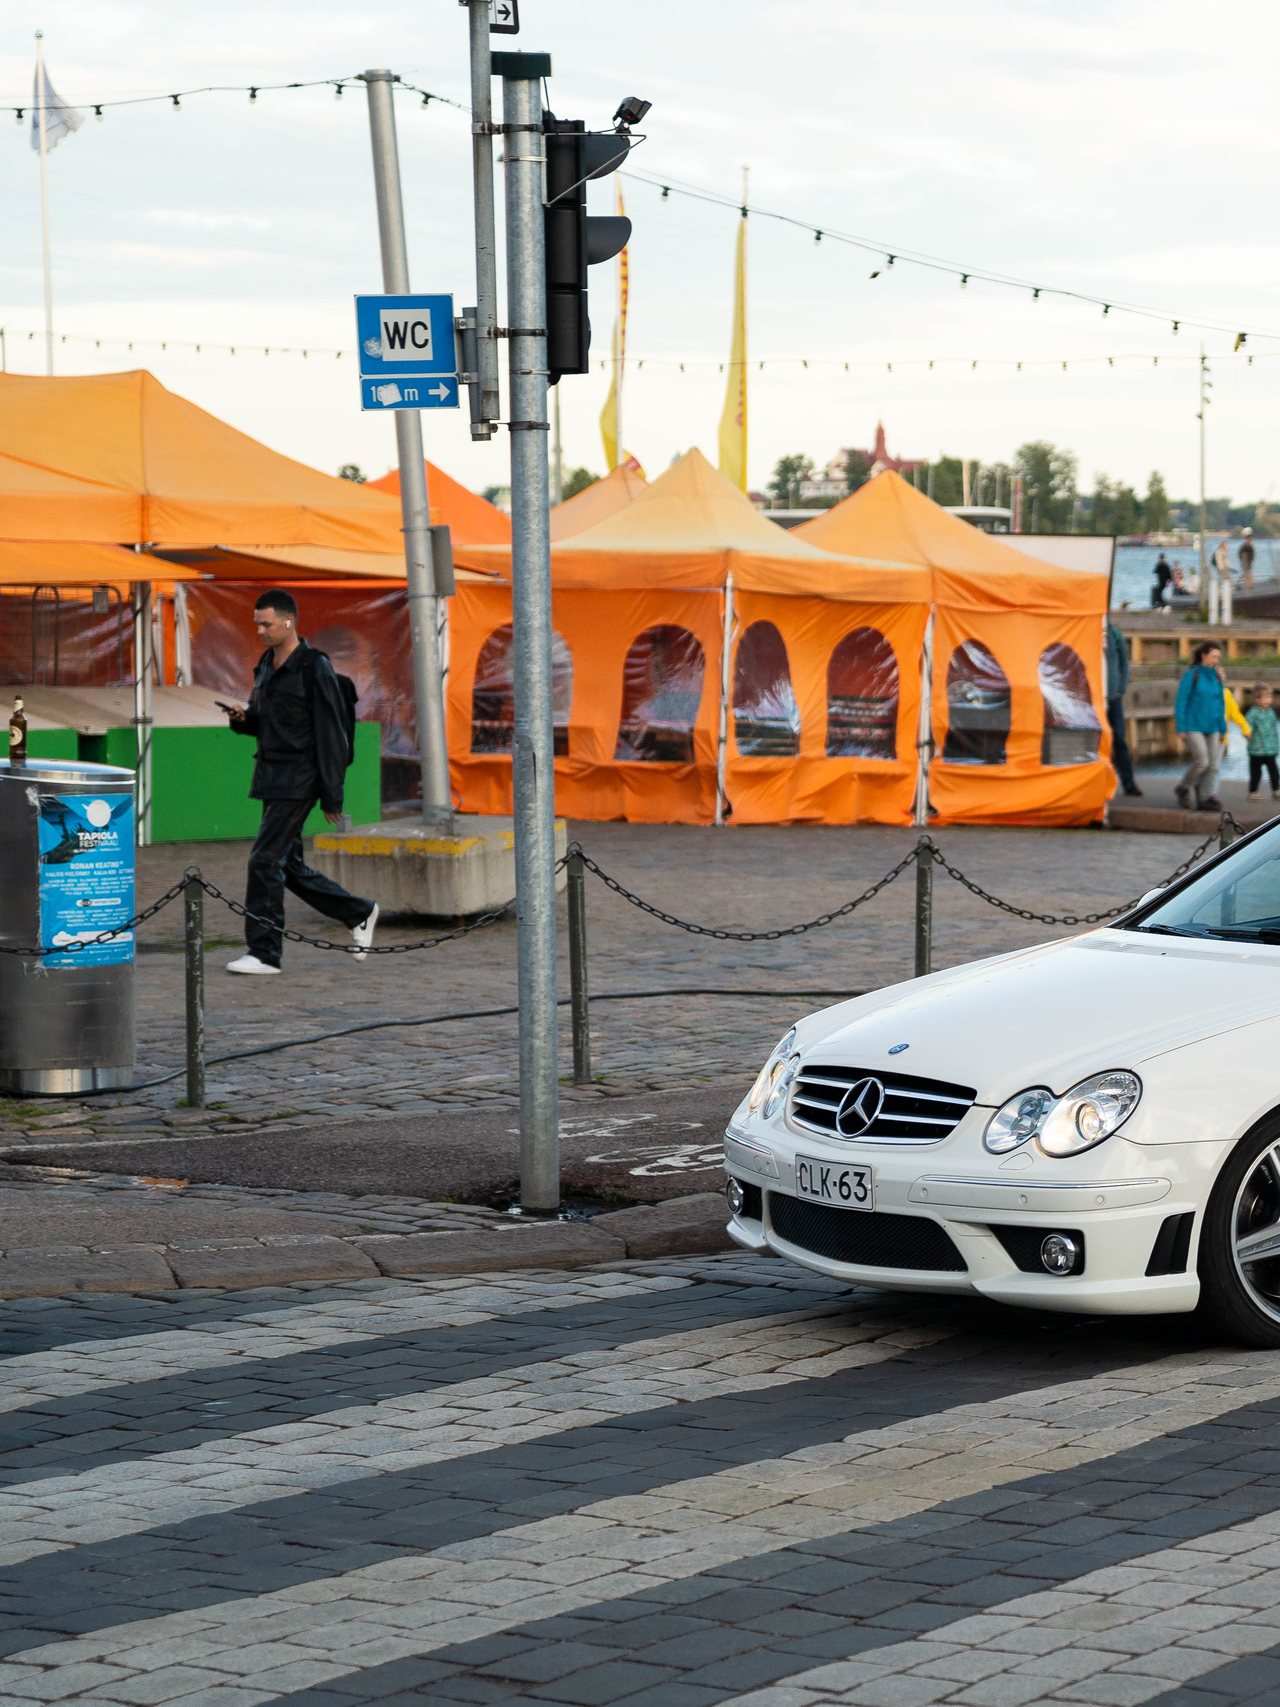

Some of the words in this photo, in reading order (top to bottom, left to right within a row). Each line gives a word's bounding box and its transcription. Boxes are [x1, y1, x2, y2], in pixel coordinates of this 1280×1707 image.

[383, 321, 429, 349] WC
[404, 388, 419, 401] m
[77, 831, 118, 841] TAPIOLA
[799, 1162, 868, 1202] CLK-63
